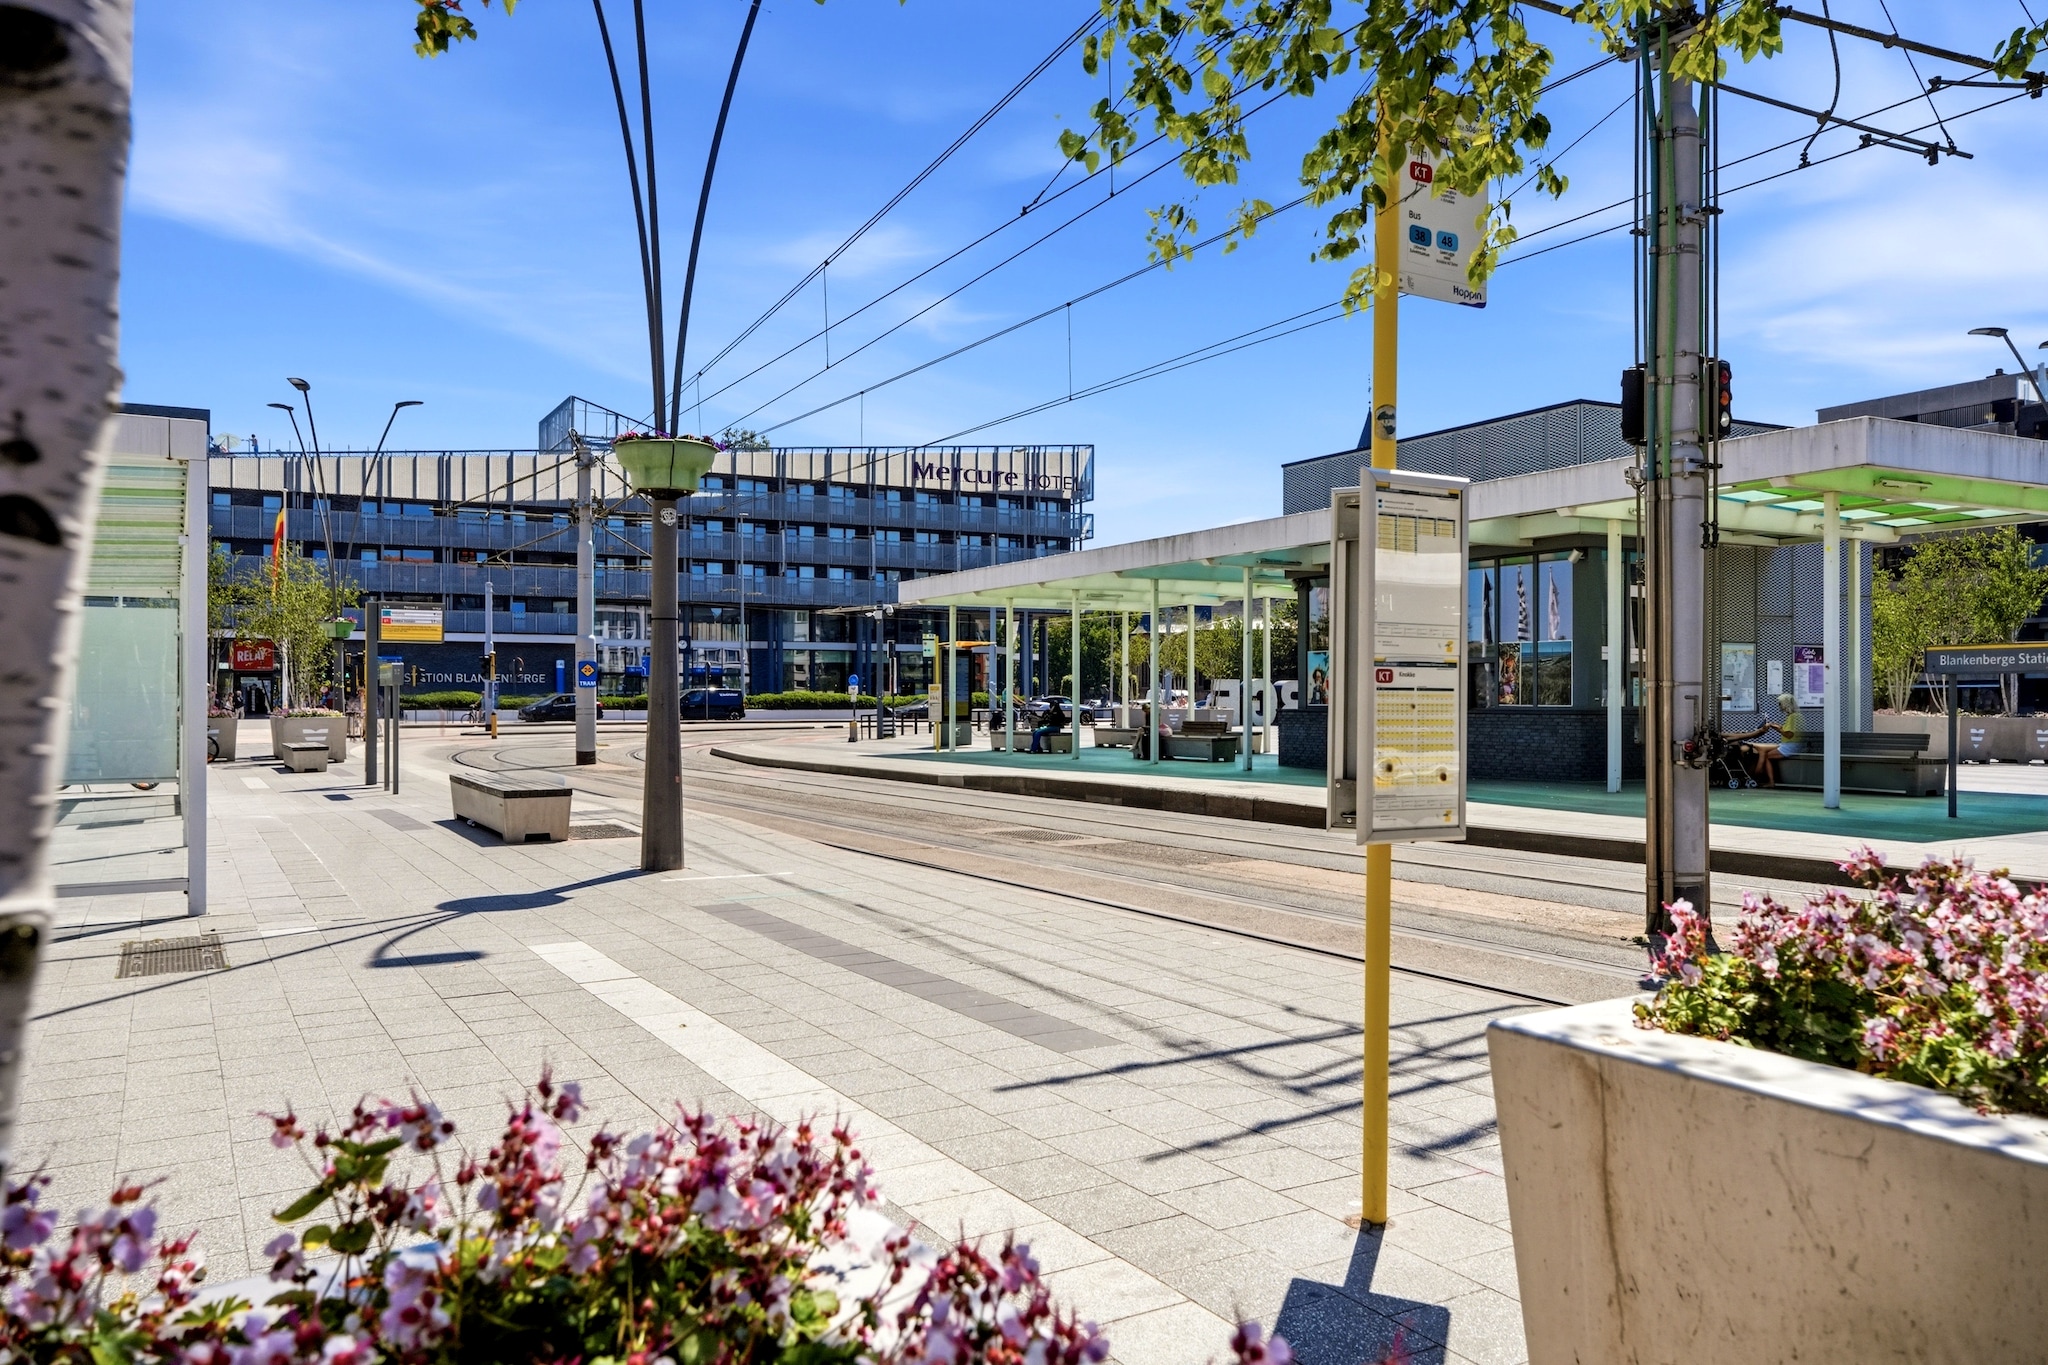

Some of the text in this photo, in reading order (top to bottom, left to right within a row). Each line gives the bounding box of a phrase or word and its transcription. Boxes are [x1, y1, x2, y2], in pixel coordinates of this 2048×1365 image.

[1414, 165, 1428, 179] KT
[1408, 210, 1421, 220] Bus
[1414, 229, 1426, 242] 38
[1441, 235, 1453, 248] 48
[1453, 285, 1482, 300] Hoppin
[913, 461, 1083, 491] Mercure HOTEL
[1939, 654, 2016, 667] Blankenberge
[404, 672, 453, 683] STION
[1378, 671, 1391, 682] KT
